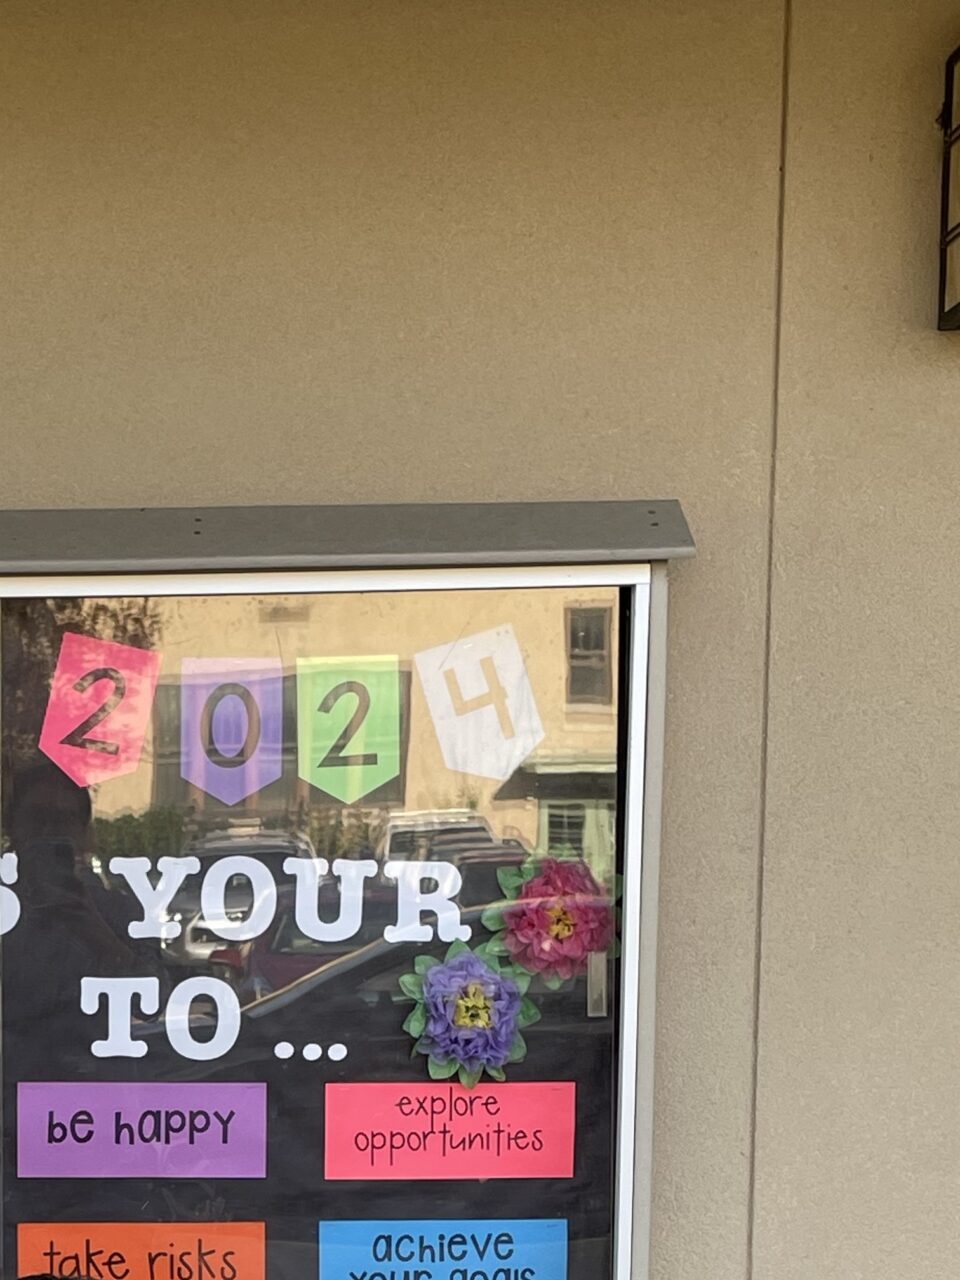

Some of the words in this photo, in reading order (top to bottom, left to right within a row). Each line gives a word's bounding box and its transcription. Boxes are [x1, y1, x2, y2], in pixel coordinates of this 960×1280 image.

[60, 656, 516, 768] 2024
[109, 855, 472, 942] YOUR
[46, 1109, 94, 1145] be
[114, 1109, 236, 1145] happy
[395, 1086, 501, 1133] explore
[354, 1122, 545, 1166] opportunities
[42, 1239, 131, 1280] take
[373, 1231, 515, 1263] achieve
